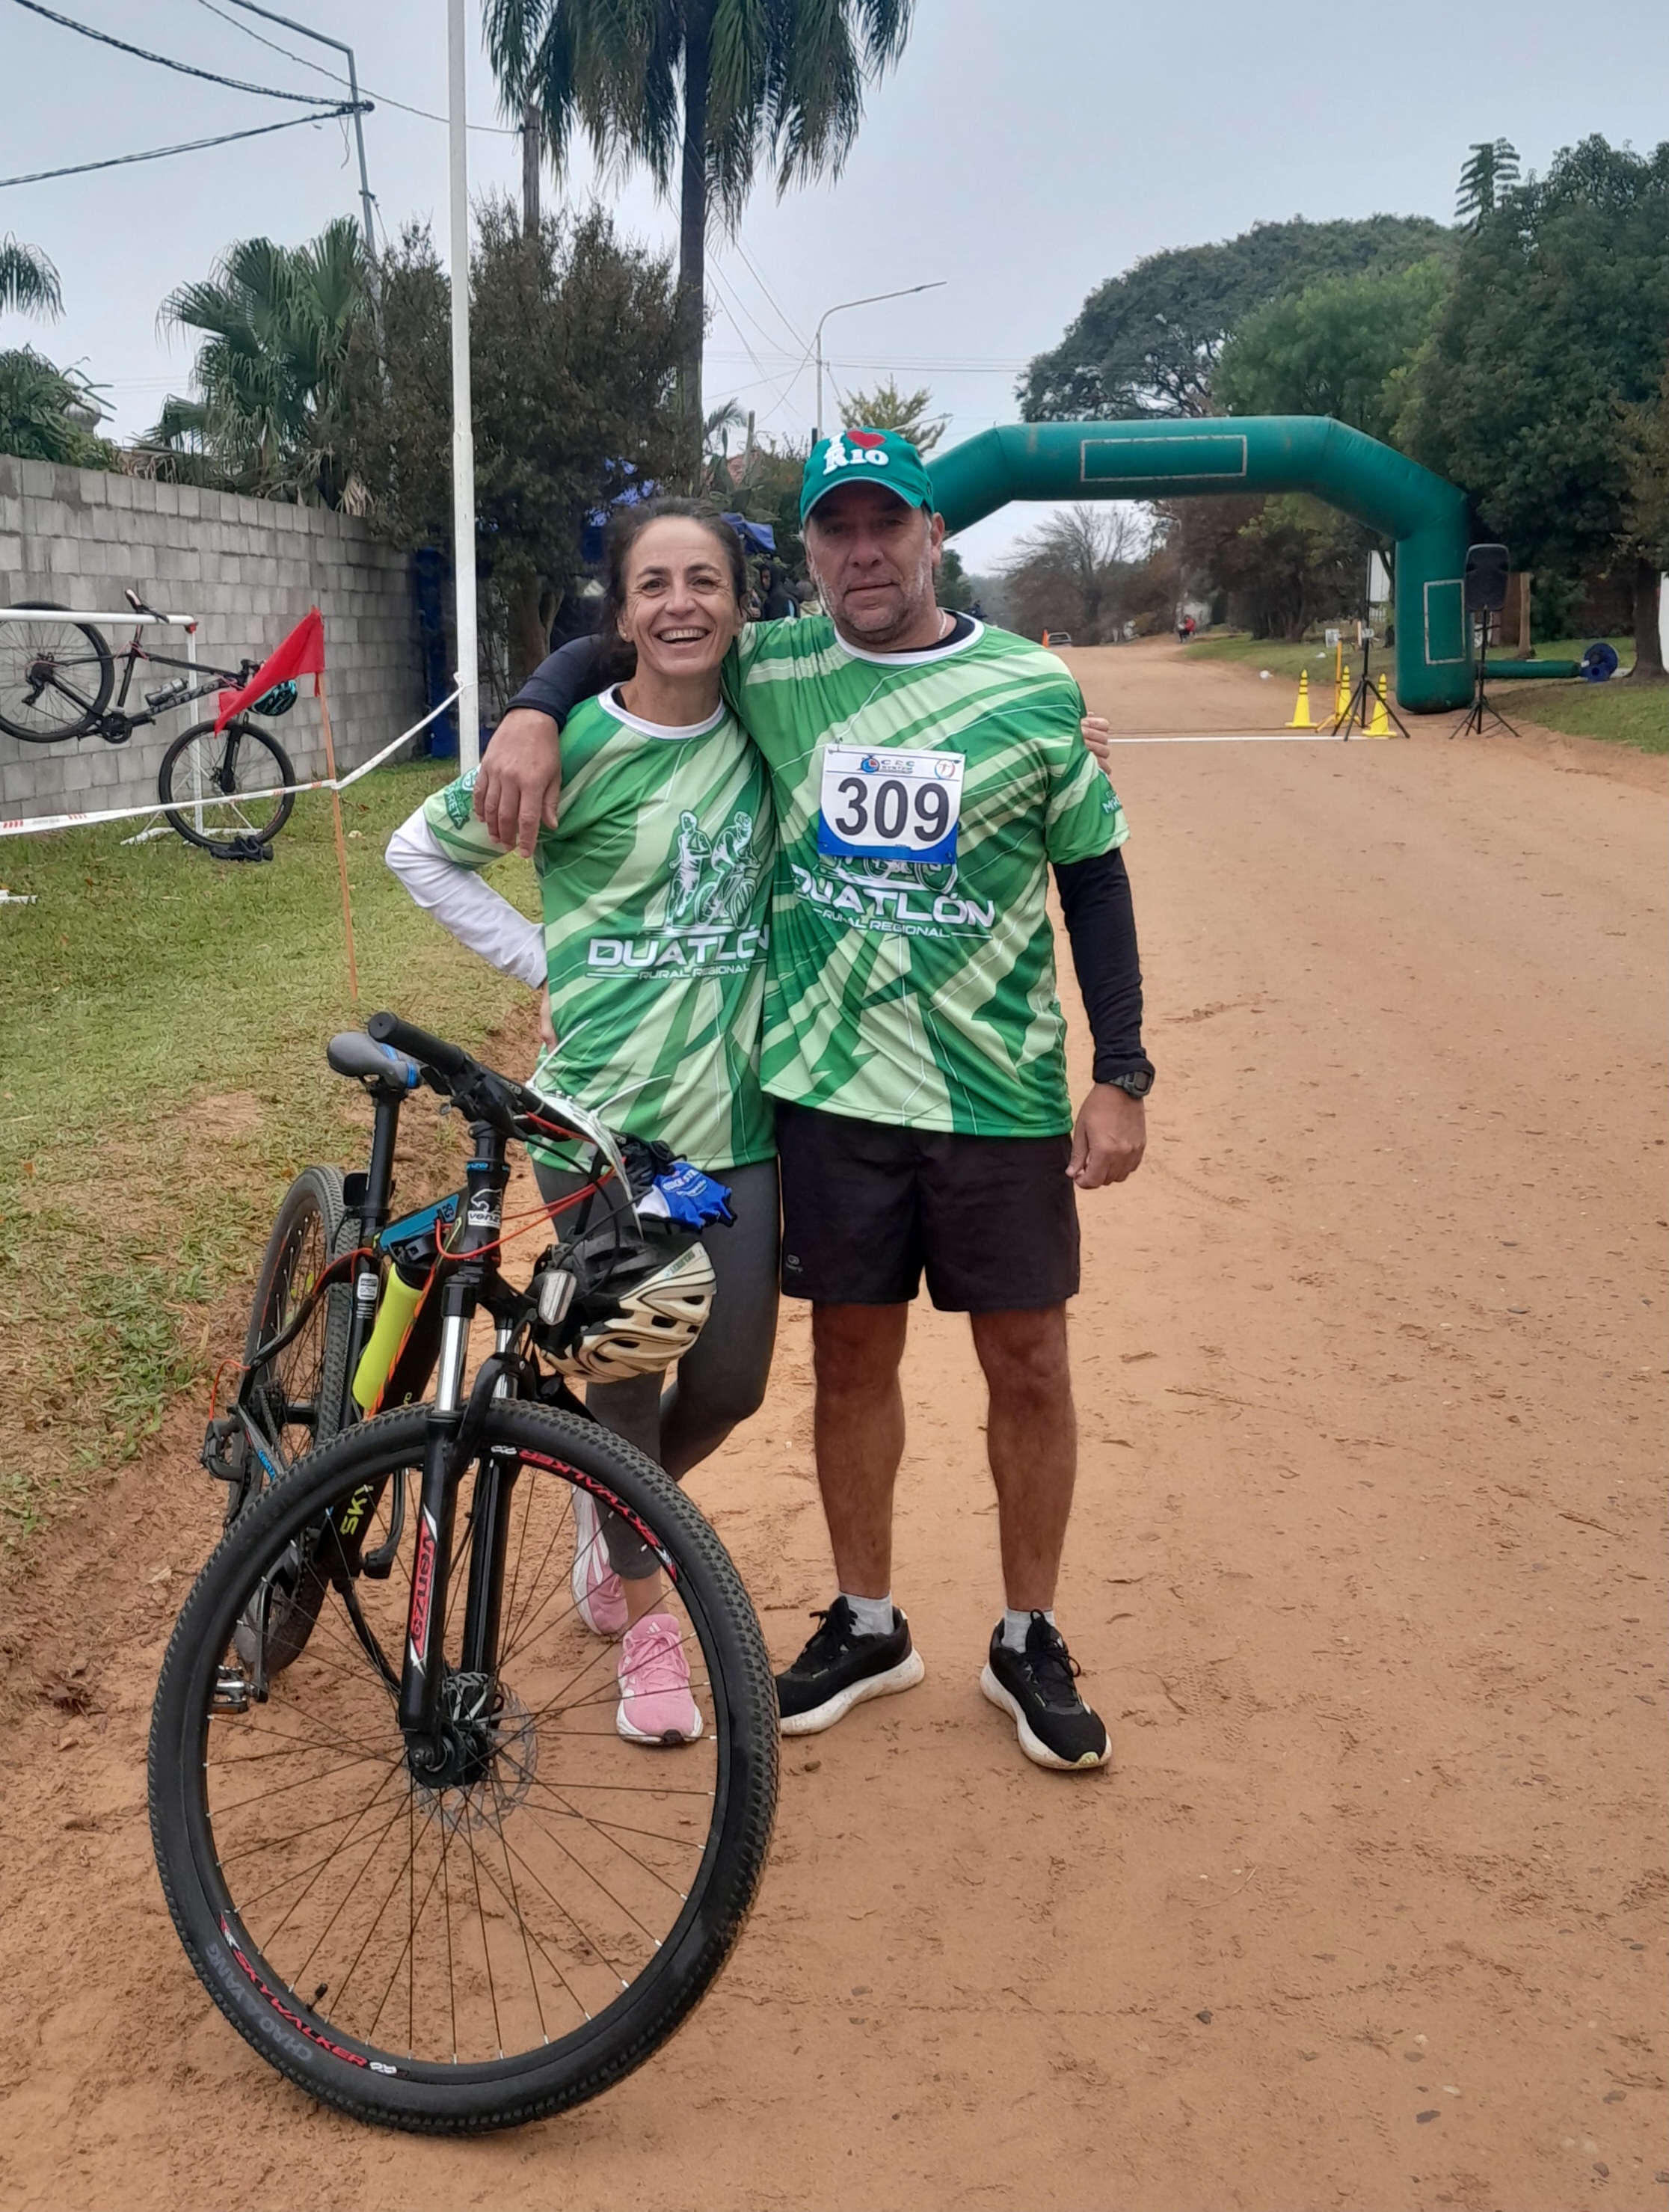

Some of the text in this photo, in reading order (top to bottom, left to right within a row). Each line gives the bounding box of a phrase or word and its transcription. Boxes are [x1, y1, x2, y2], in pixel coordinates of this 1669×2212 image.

[834, 777, 950, 842] 309
[869, 920, 950, 938] REGIONAL
[638, 962, 750, 980] RURAL REGIONAL
[519, 1449, 662, 1547] SKYWALKER
[233, 1950, 368, 2067] SKYWALKER
